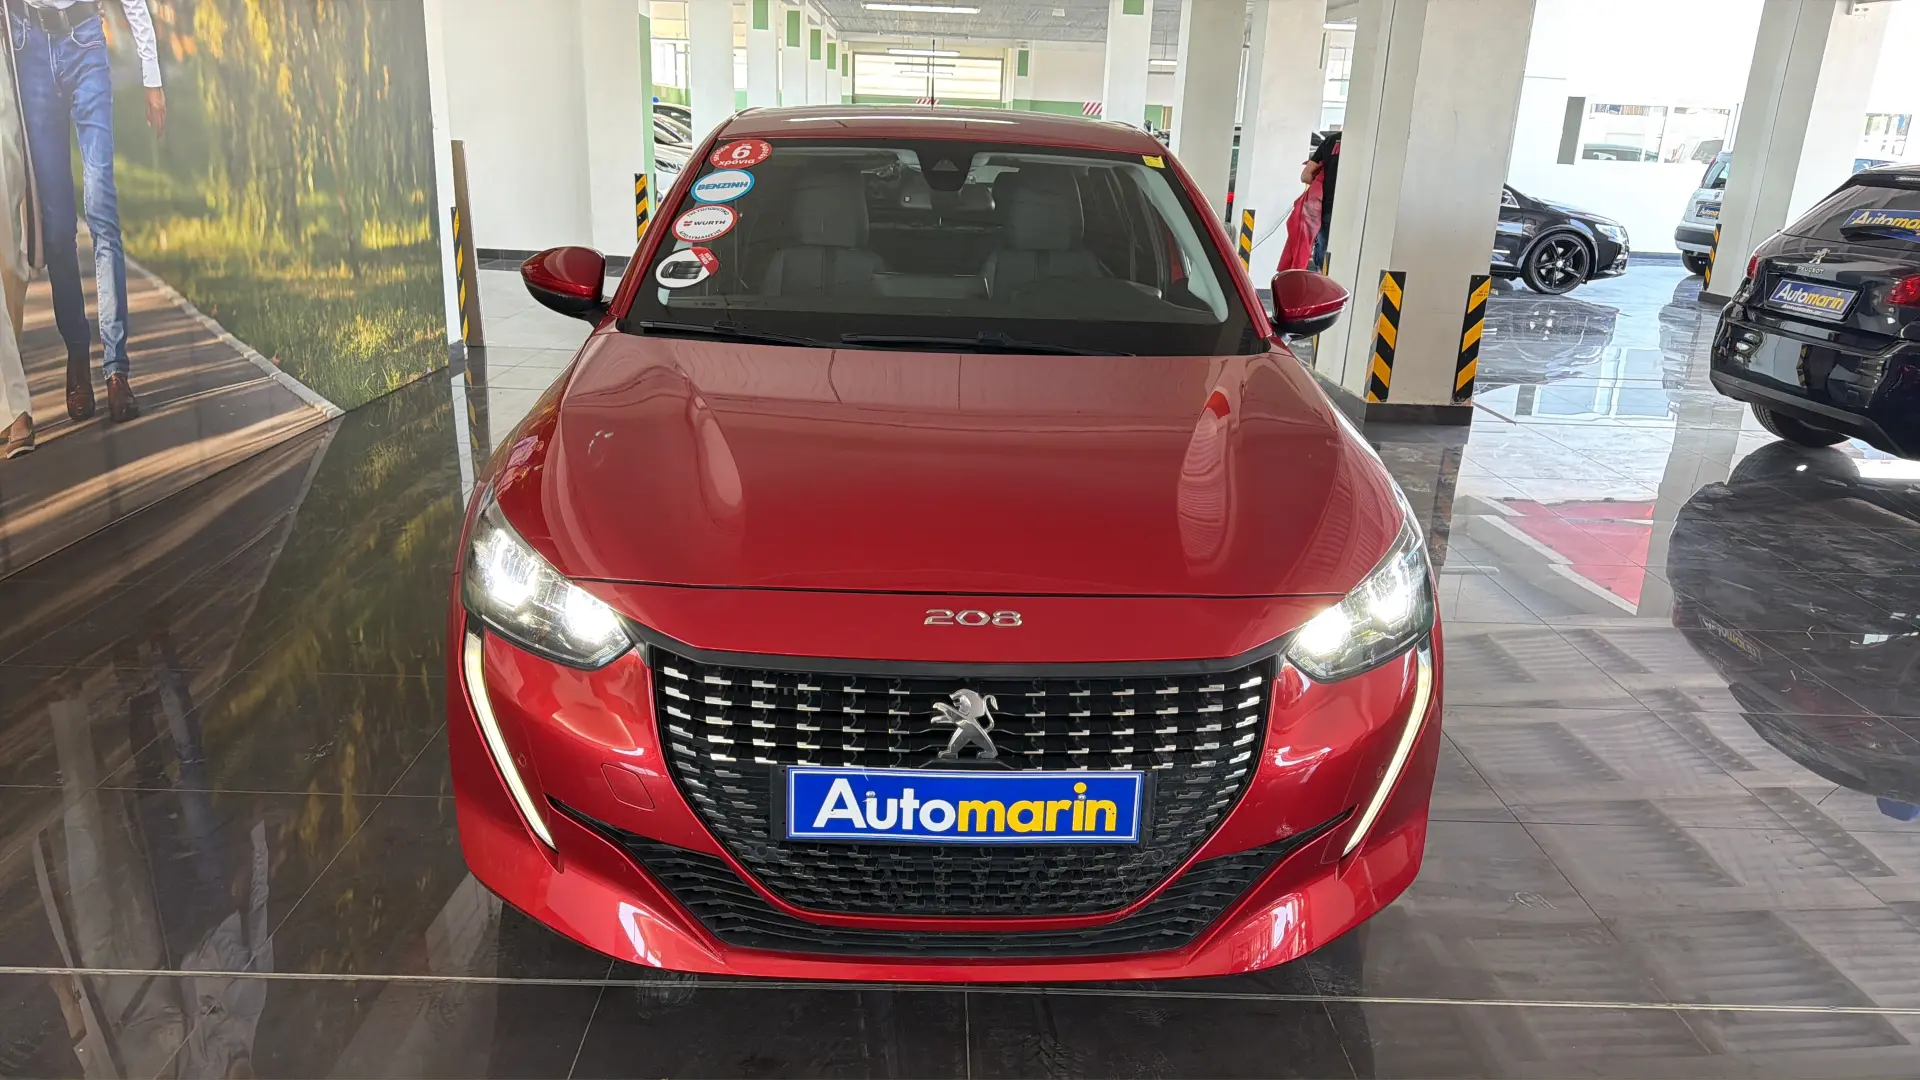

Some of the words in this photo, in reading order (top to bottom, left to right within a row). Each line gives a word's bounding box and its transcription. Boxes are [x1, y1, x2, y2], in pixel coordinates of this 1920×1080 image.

[732, 145, 752, 159] 6
[1797, 265, 1825, 275] PEUGEOT
[1775, 283, 1845, 310] Automarin
[923, 608, 1023, 627] 208
[813, 777, 1116, 833] Automarin
